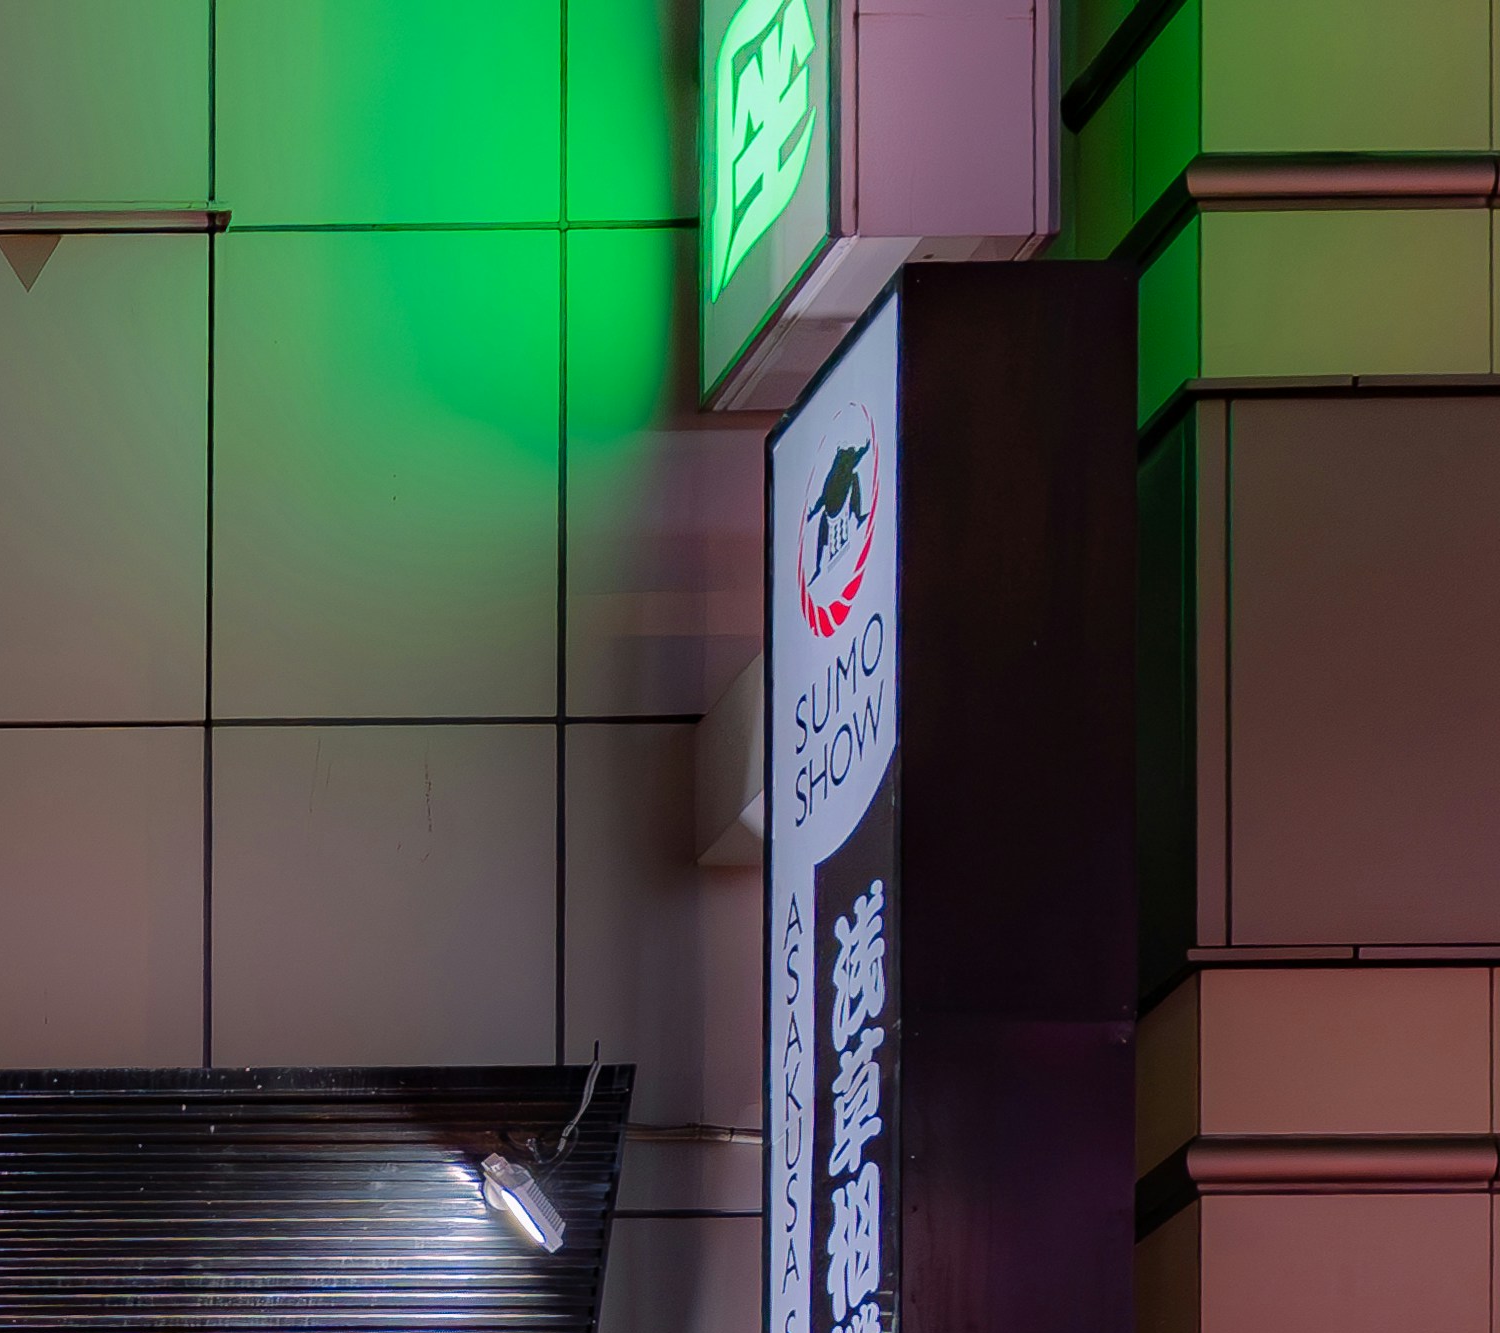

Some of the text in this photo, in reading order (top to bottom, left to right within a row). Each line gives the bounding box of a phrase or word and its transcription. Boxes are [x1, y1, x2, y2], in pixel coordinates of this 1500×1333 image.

[793, 679, 885, 828] SHOW
[794, 611, 884, 753] SUMO
[781, 892, 805, 1283] ASAKUSA
